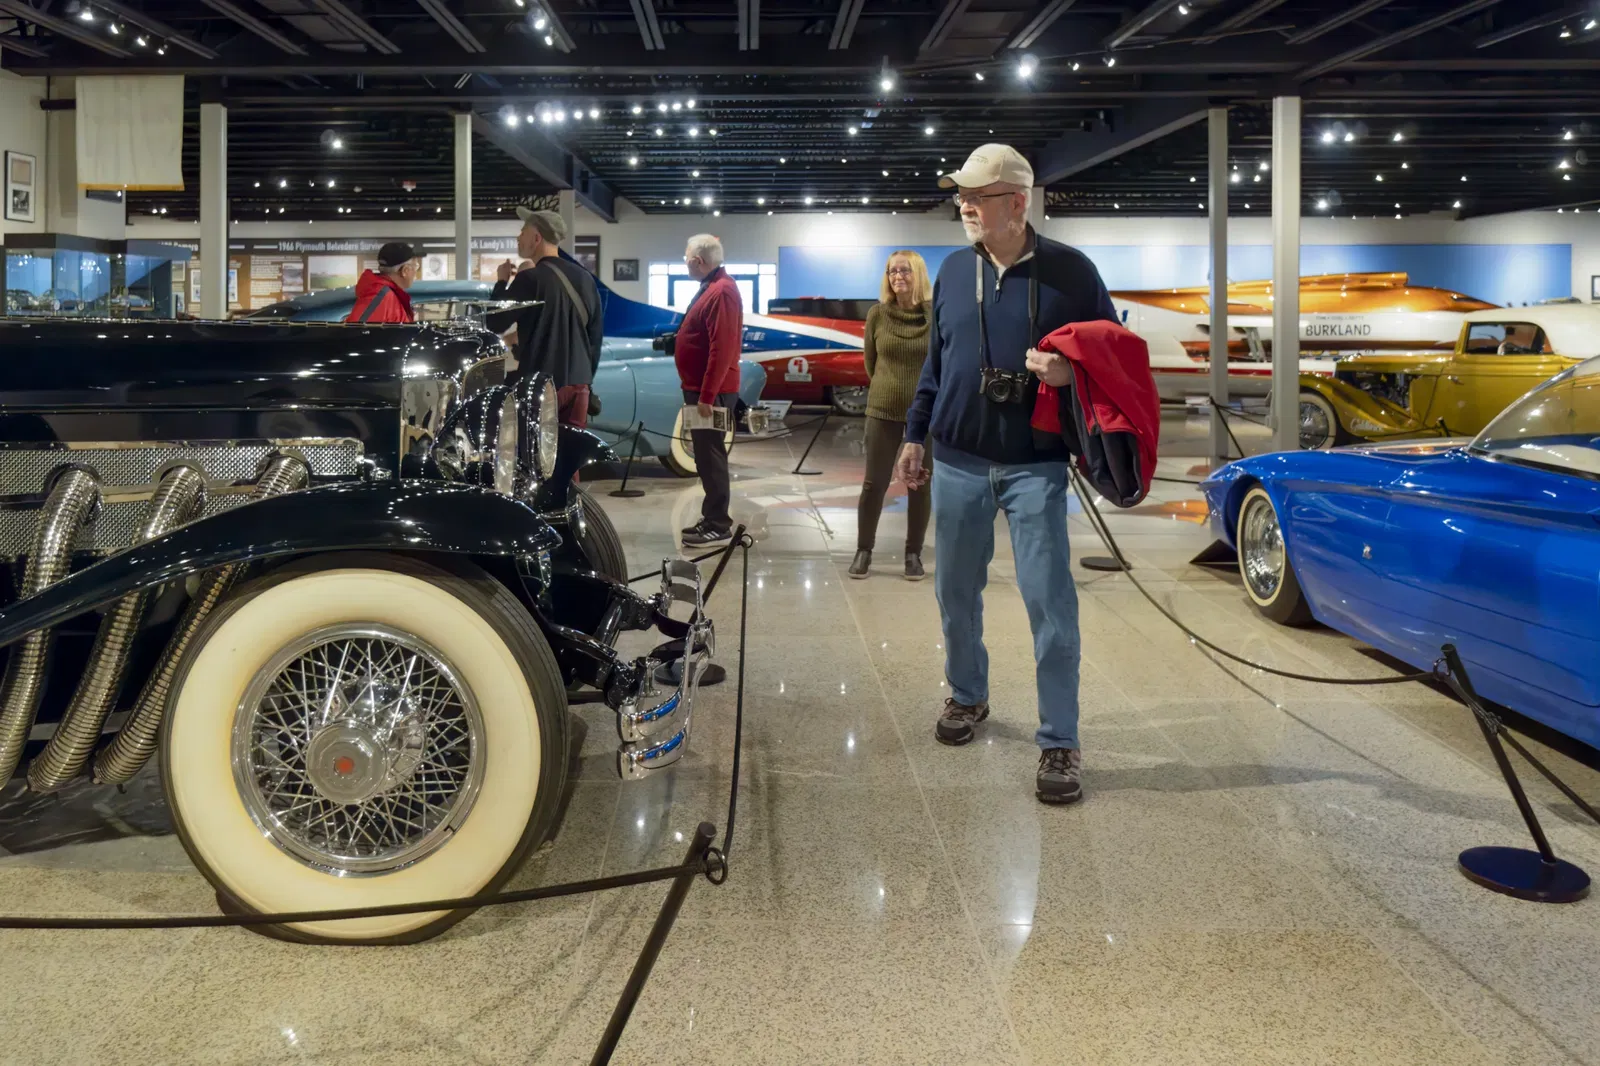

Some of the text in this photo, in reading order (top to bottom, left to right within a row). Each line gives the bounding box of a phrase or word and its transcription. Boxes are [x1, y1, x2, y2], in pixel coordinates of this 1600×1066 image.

[279, 242, 294, 252] 1966
[295, 241, 326, 253] Plymouth
[327, 241, 359, 251] Belvedere
[480, 239, 505, 251] Landy's
[1305, 324, 1371, 337] BURKLAND
